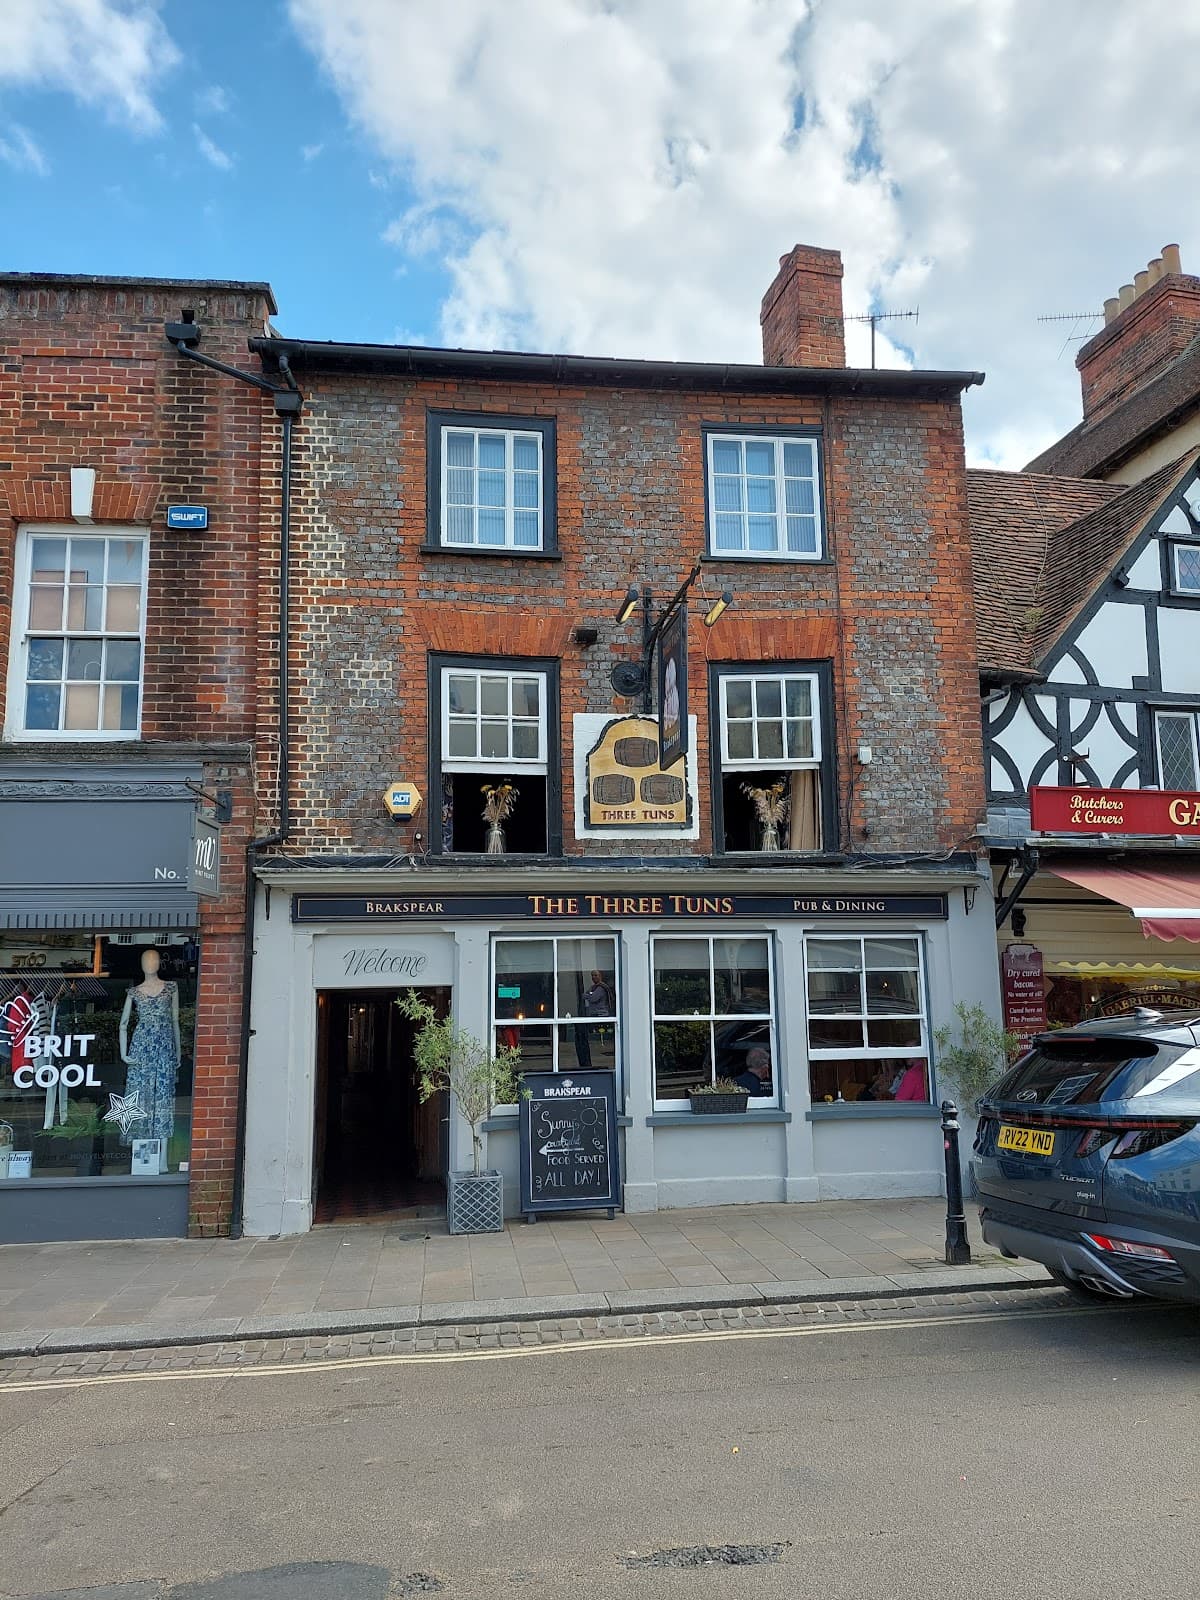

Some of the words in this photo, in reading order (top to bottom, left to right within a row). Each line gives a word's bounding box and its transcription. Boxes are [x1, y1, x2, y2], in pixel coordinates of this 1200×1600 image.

[171, 513, 205, 521] SWIFT
[393, 794, 410, 803] ADT
[1070, 794, 1124, 810] Butchers
[601, 810, 636, 820] THREE
[642, 809, 675, 820] TUNS
[1071, 811, 1082, 824] &
[1084, 811, 1124, 825] Curers
[154, 867, 180, 880] No.
[821, 900, 832, 911] &
[343, 947, 428, 978] Welcome
[1007, 969, 1020, 979] Dry
[1022, 968, 1040, 977] cured
[23, 1034, 96, 1058] BRIT
[13, 1063, 102, 1089] COOL
[544, 1087, 592, 1097] BRAKSPEAR
[537, 1110, 575, 1144] Sunny
[1003, 1128, 1030, 1148] RV22
[1031, 1131, 1052, 1151] YND
[544, 1171, 566, 1187] ALL
